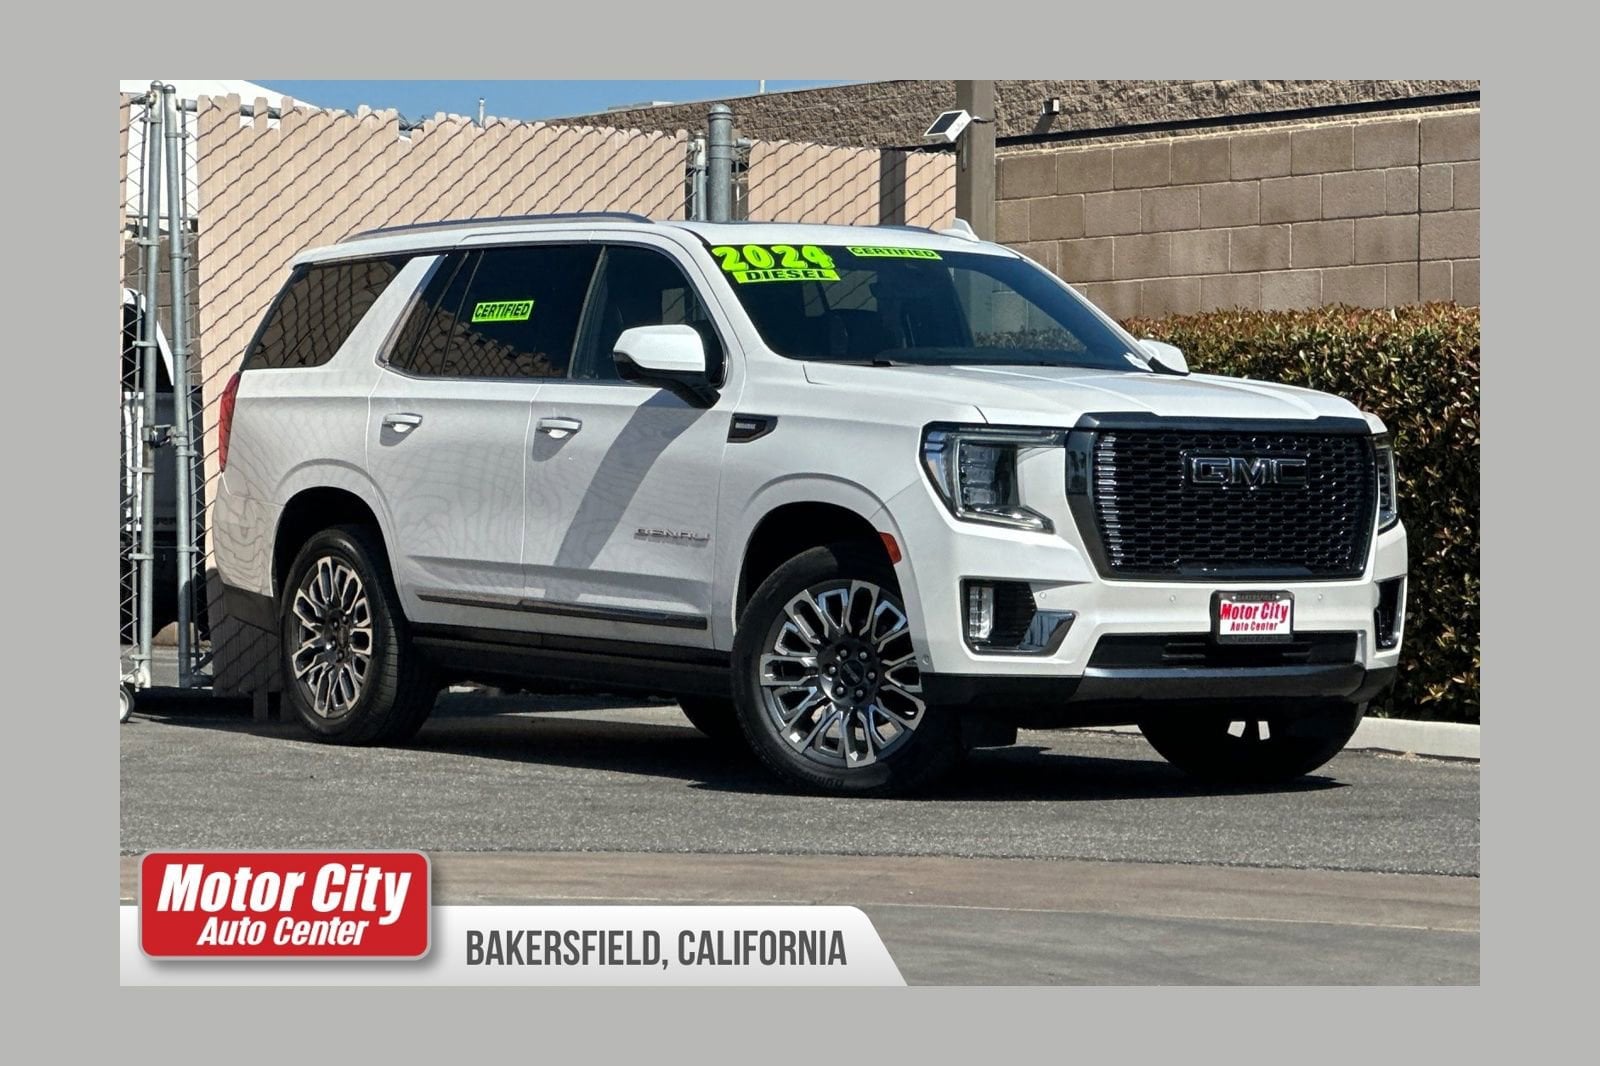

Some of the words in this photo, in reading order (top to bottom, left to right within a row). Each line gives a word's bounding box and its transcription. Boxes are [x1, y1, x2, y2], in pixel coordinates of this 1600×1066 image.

[711, 244, 836, 271] 2024
[850, 246, 937, 257] CERTIFIED
[745, 269, 832, 281] DIESEL
[475, 302, 531, 318] CERTIFIED
[1191, 457, 1307, 484] GMC
[1219, 603, 1260, 621] Motor
[1260, 602, 1289, 624] City
[1230, 621, 1249, 632] Auto
[1250, 620, 1278, 632] Center
